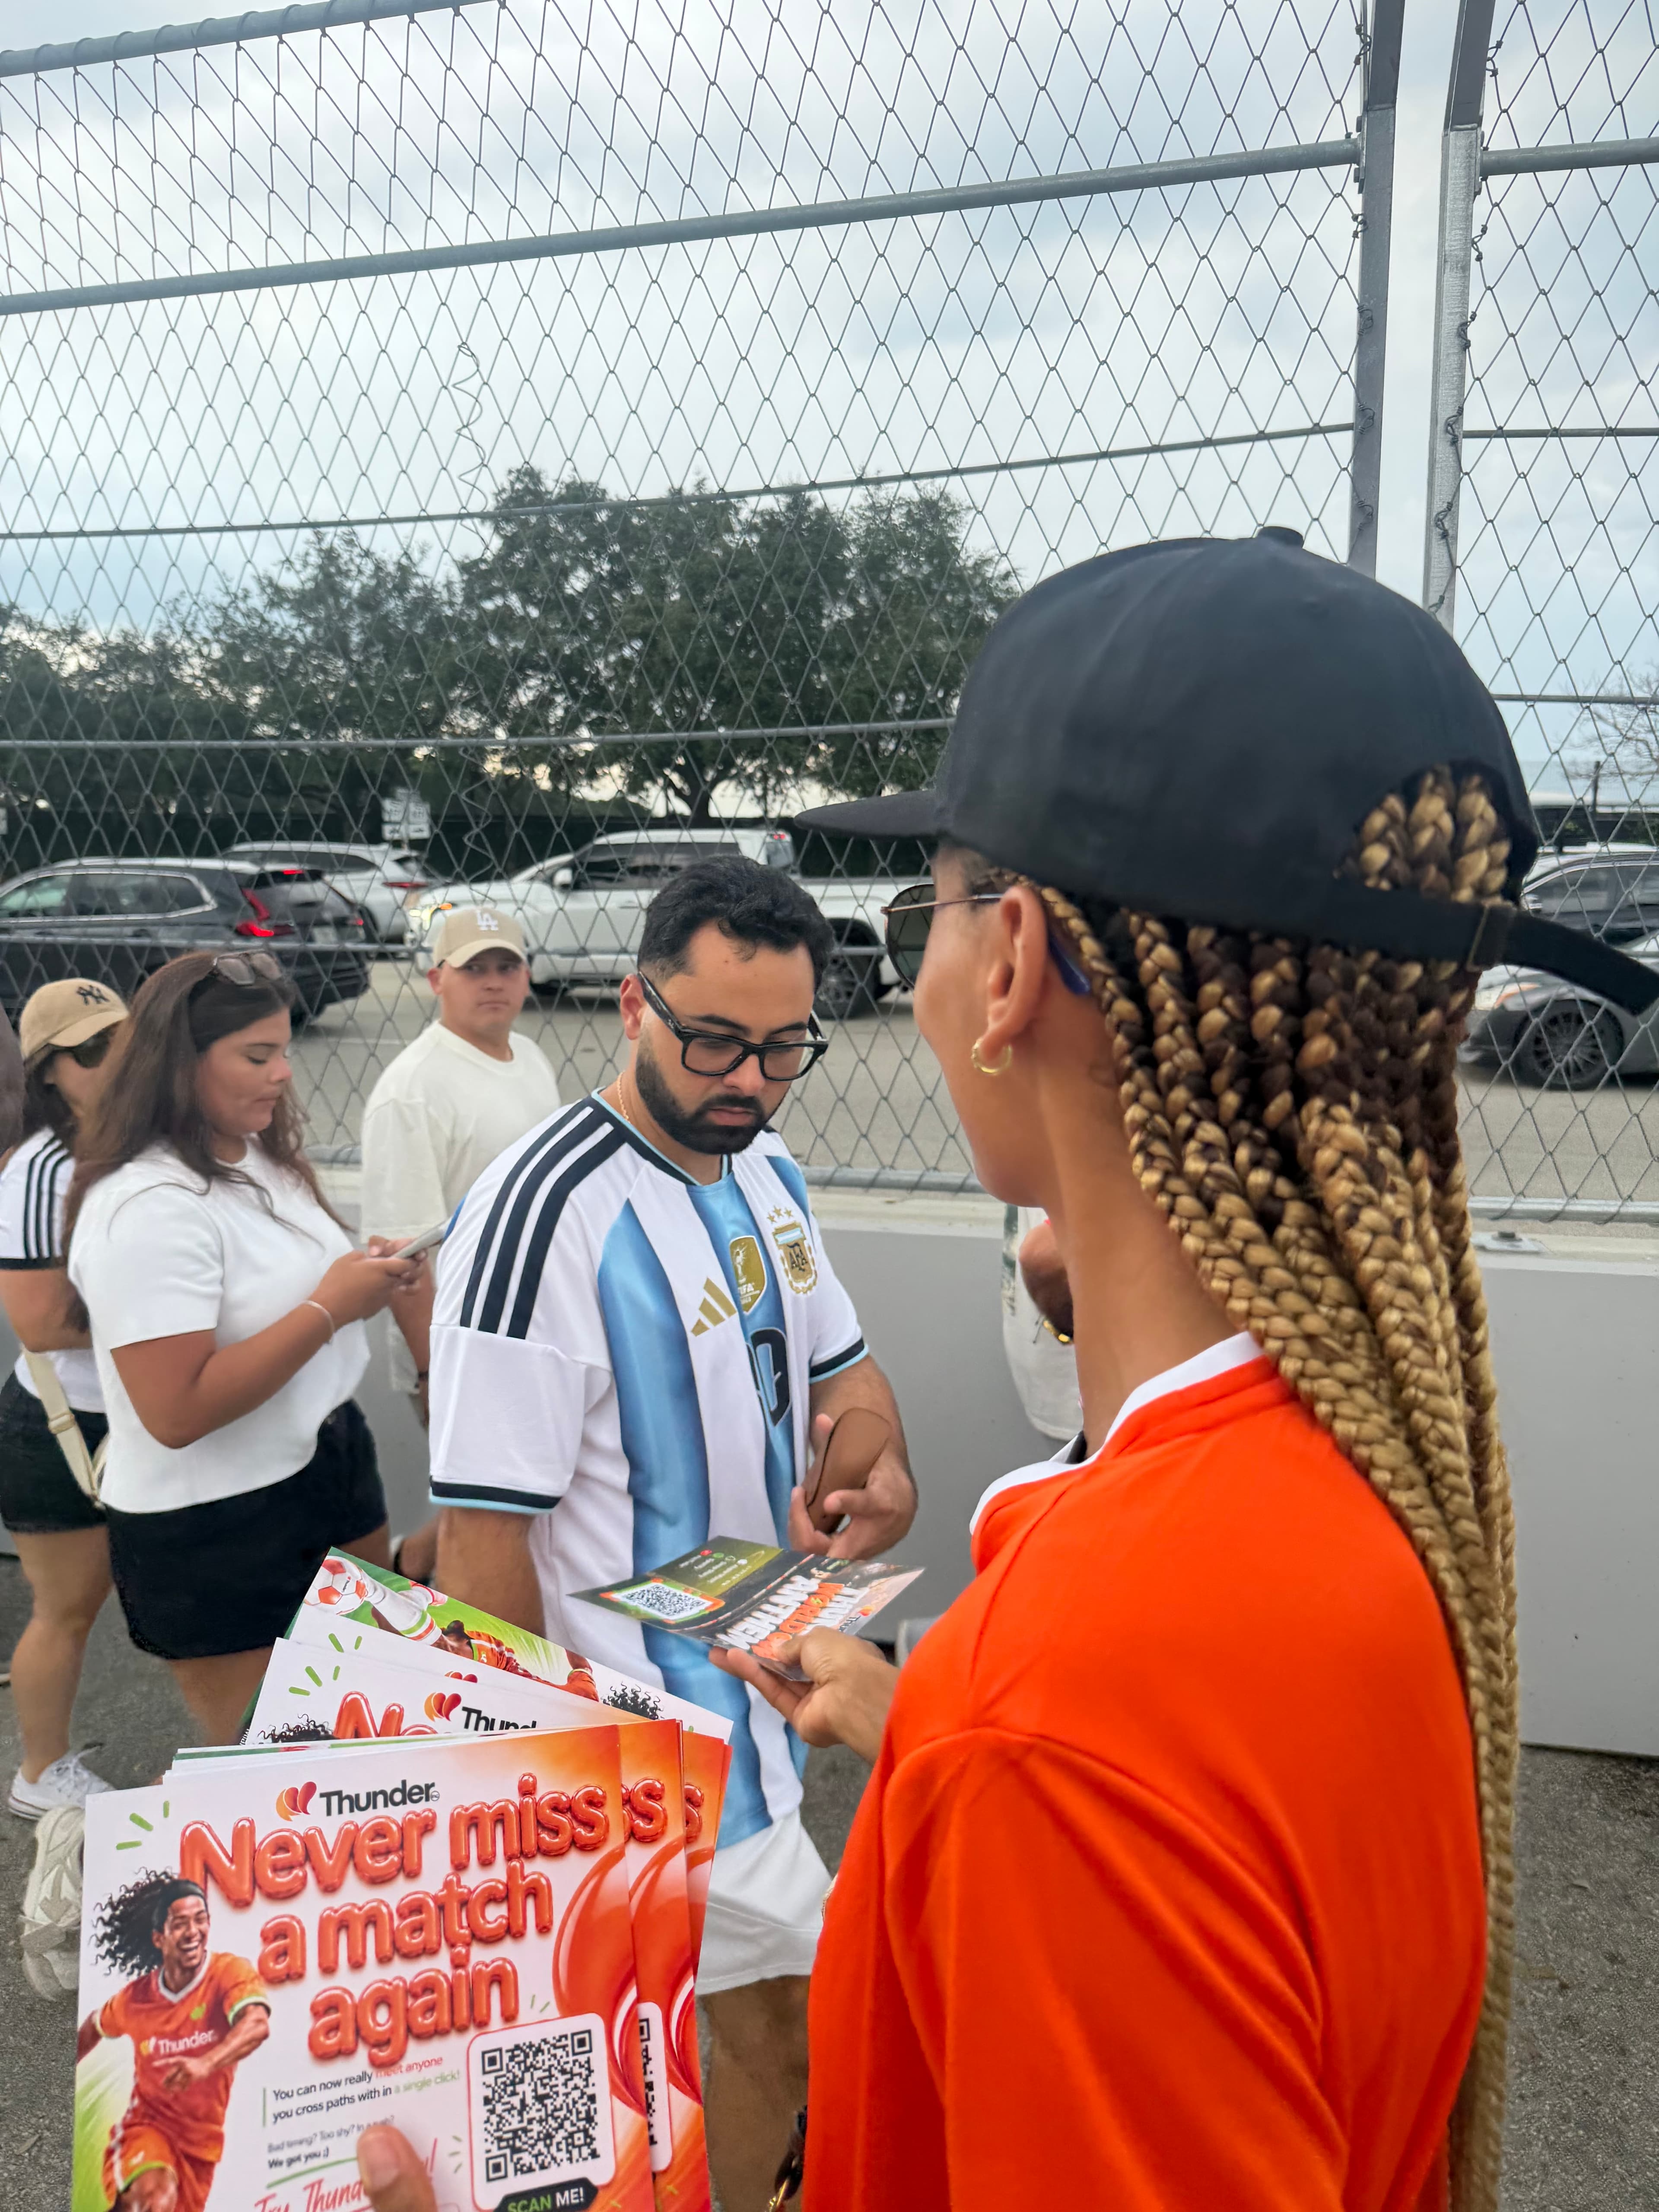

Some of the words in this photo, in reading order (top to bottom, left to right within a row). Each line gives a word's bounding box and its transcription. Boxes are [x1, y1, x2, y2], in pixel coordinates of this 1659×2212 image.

[476, 909, 499, 931] LA
[76, 985, 111, 1006] NY
[715, 1575, 821, 1650] ANTHEM
[779, 1582, 845, 1634] WORLD
[838, 1615, 861, 1632] Thun
[319, 1779, 435, 1817] Thunder
[179, 1808, 437, 1907] Never
[449, 1773, 610, 1870] miss
[258, 1914, 306, 1984] a
[318, 1859, 553, 1974] match
[308, 1945, 519, 2068] again
[158, 2029, 215, 2055] Thunder
[273, 2089, 294, 2101] You
[296, 2085, 316, 2096] can
[319, 2079, 342, 2091] now
[344, 2071, 373, 2085] really
[405, 2057, 443, 2072] anyone
[273, 2109, 293, 2125] you
[296, 2102, 324, 2116] cross
[326, 2094, 356, 2112] paths
[358, 2088, 380, 2102] with
[382, 2085, 392, 2096] in
[403, 2078, 432, 2092] single
[434, 2069, 460, 2085] click!
[507, 2194, 552, 2212] SCAN
[555, 2187, 585, 2209] ME!
